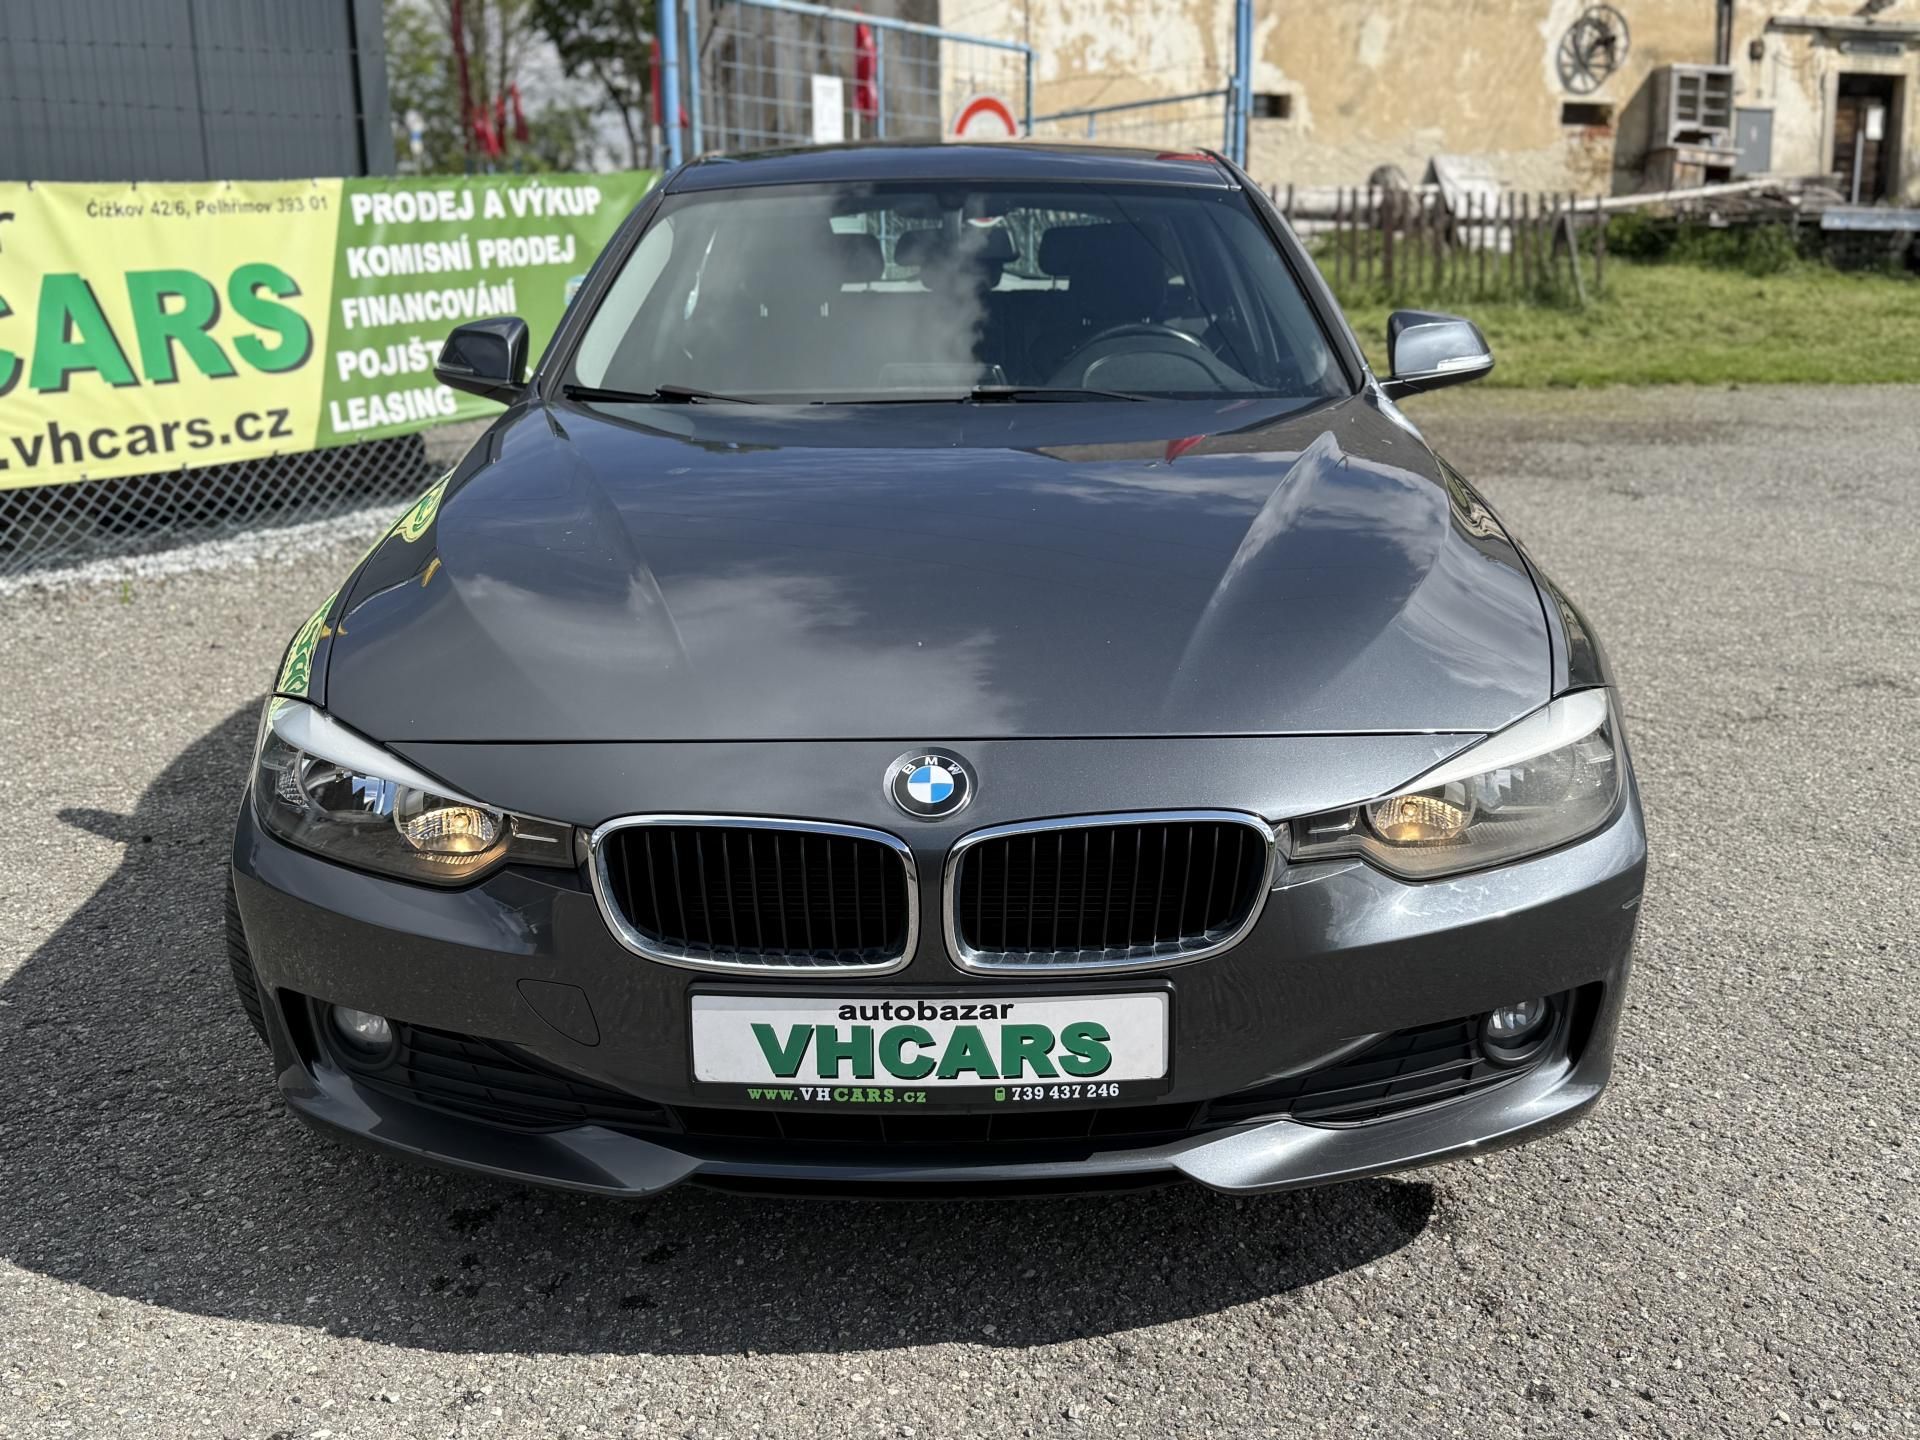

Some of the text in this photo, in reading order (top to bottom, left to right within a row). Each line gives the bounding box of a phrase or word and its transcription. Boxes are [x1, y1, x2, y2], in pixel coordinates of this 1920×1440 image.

[276, 198, 306, 213] 393
[310, 195, 329, 211] 01
[350, 180, 602, 225] PRODEJ A VÝKUP
[346, 233, 576, 279] KOMISNÍ PRODEJ
[341, 278, 517, 329] FINANCOVÁNÍ
[330, 386, 457, 432] LEASING
[901, 756, 962, 776] BMW
[838, 1001, 1014, 1021] autobazar
[750, 1022, 1112, 1080] VHCARS
[747, 1087, 926, 1103] www.VHCARS.cz
[1012, 1083, 1120, 1101] 739 437 246
